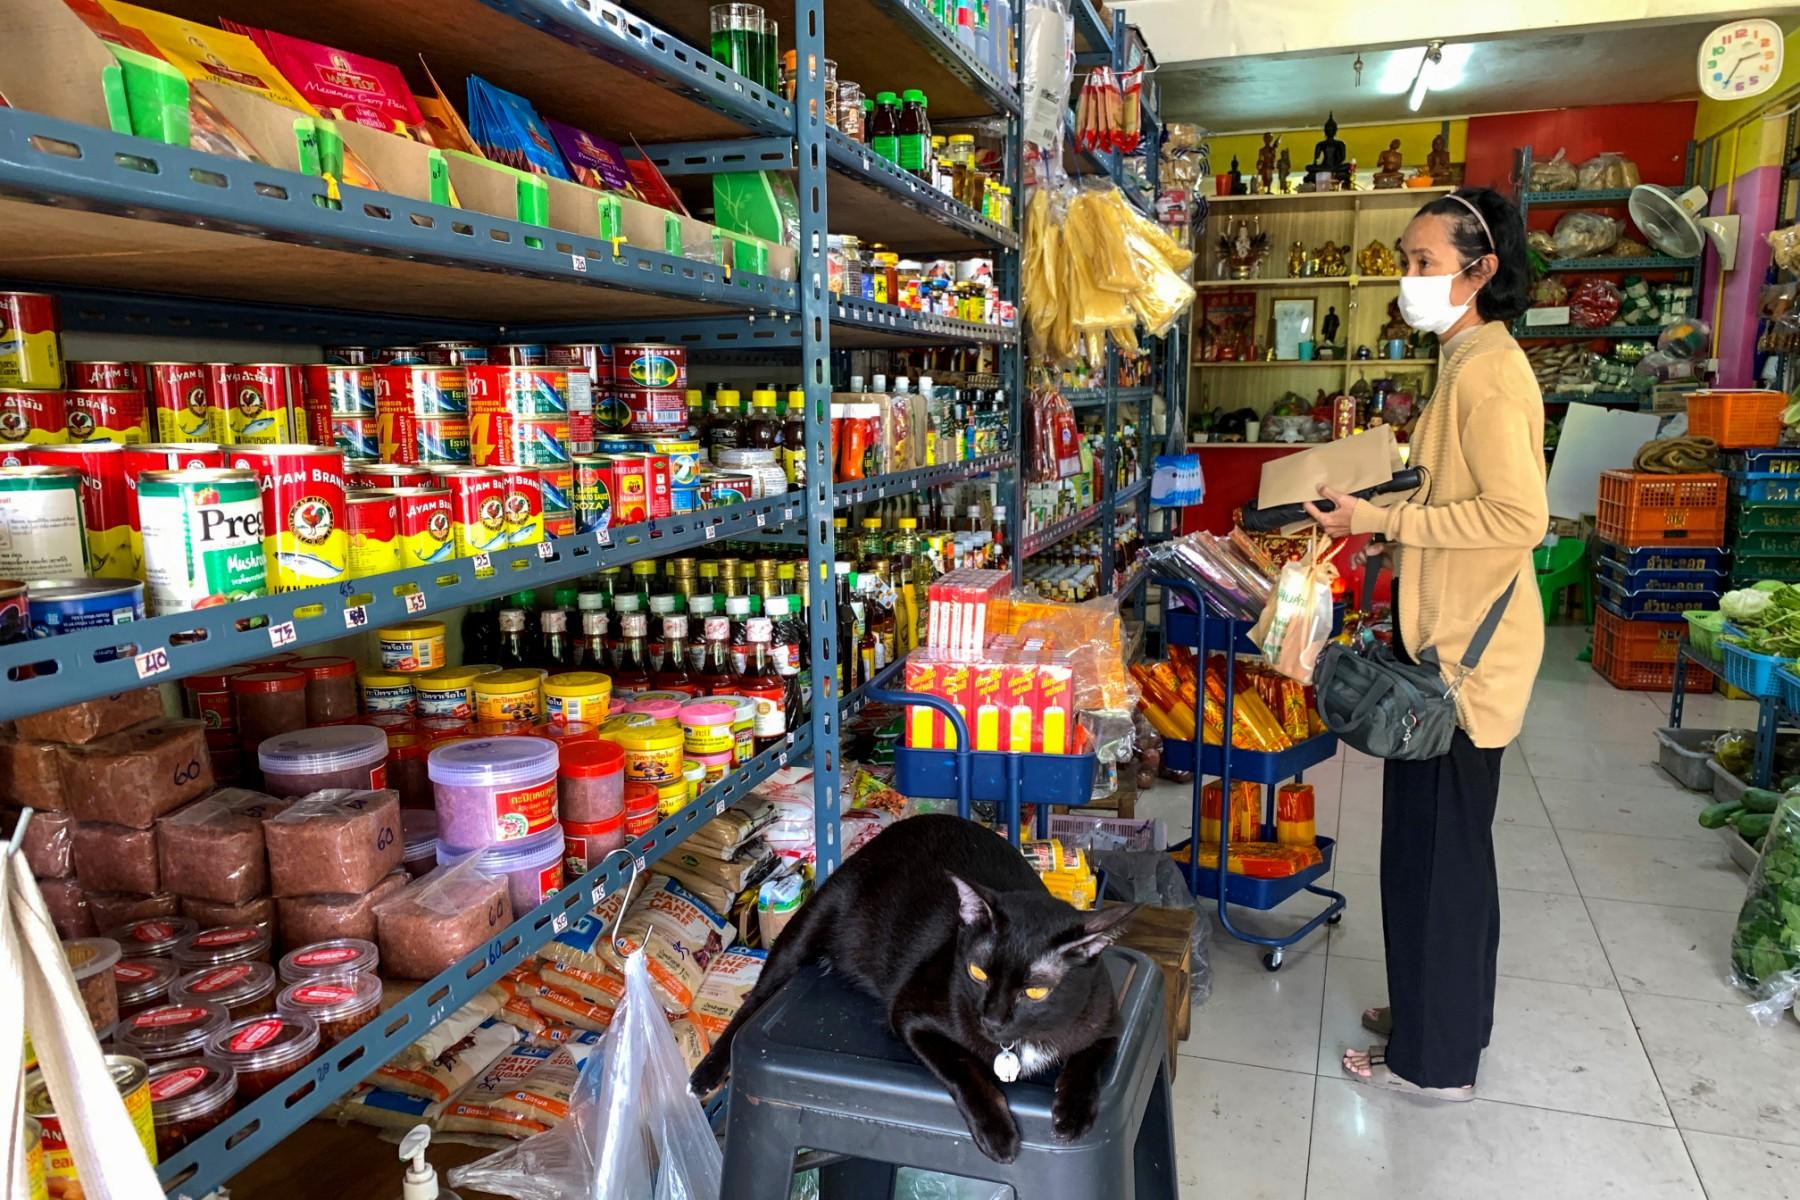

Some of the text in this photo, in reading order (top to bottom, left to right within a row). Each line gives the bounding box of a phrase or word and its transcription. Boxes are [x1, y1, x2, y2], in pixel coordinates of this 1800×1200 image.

[88, 368, 121, 384] AYAM
[168, 370, 197, 385] AYAM
[77, 397, 117, 415] BRAND
[470, 412, 497, 466] 4
[261, 471, 306, 493] AYAM
[460, 481, 490, 498] AYAM
[406, 502, 437, 518] AYAM
[574, 502, 604, 511] ROZA
[410, 594, 425, 610] 55
[274, 624, 293, 644] 75
[145, 652, 168, 673] 40
[173, 759, 200, 786] 60
[377, 827, 394, 851] 60
[489, 899, 503, 926] 60
[649, 899, 697, 924] CANE
[653, 890, 710, 928] NATURAL
[489, 940, 502, 965] 60
[488, 1071, 528, 1079] SUGAR
